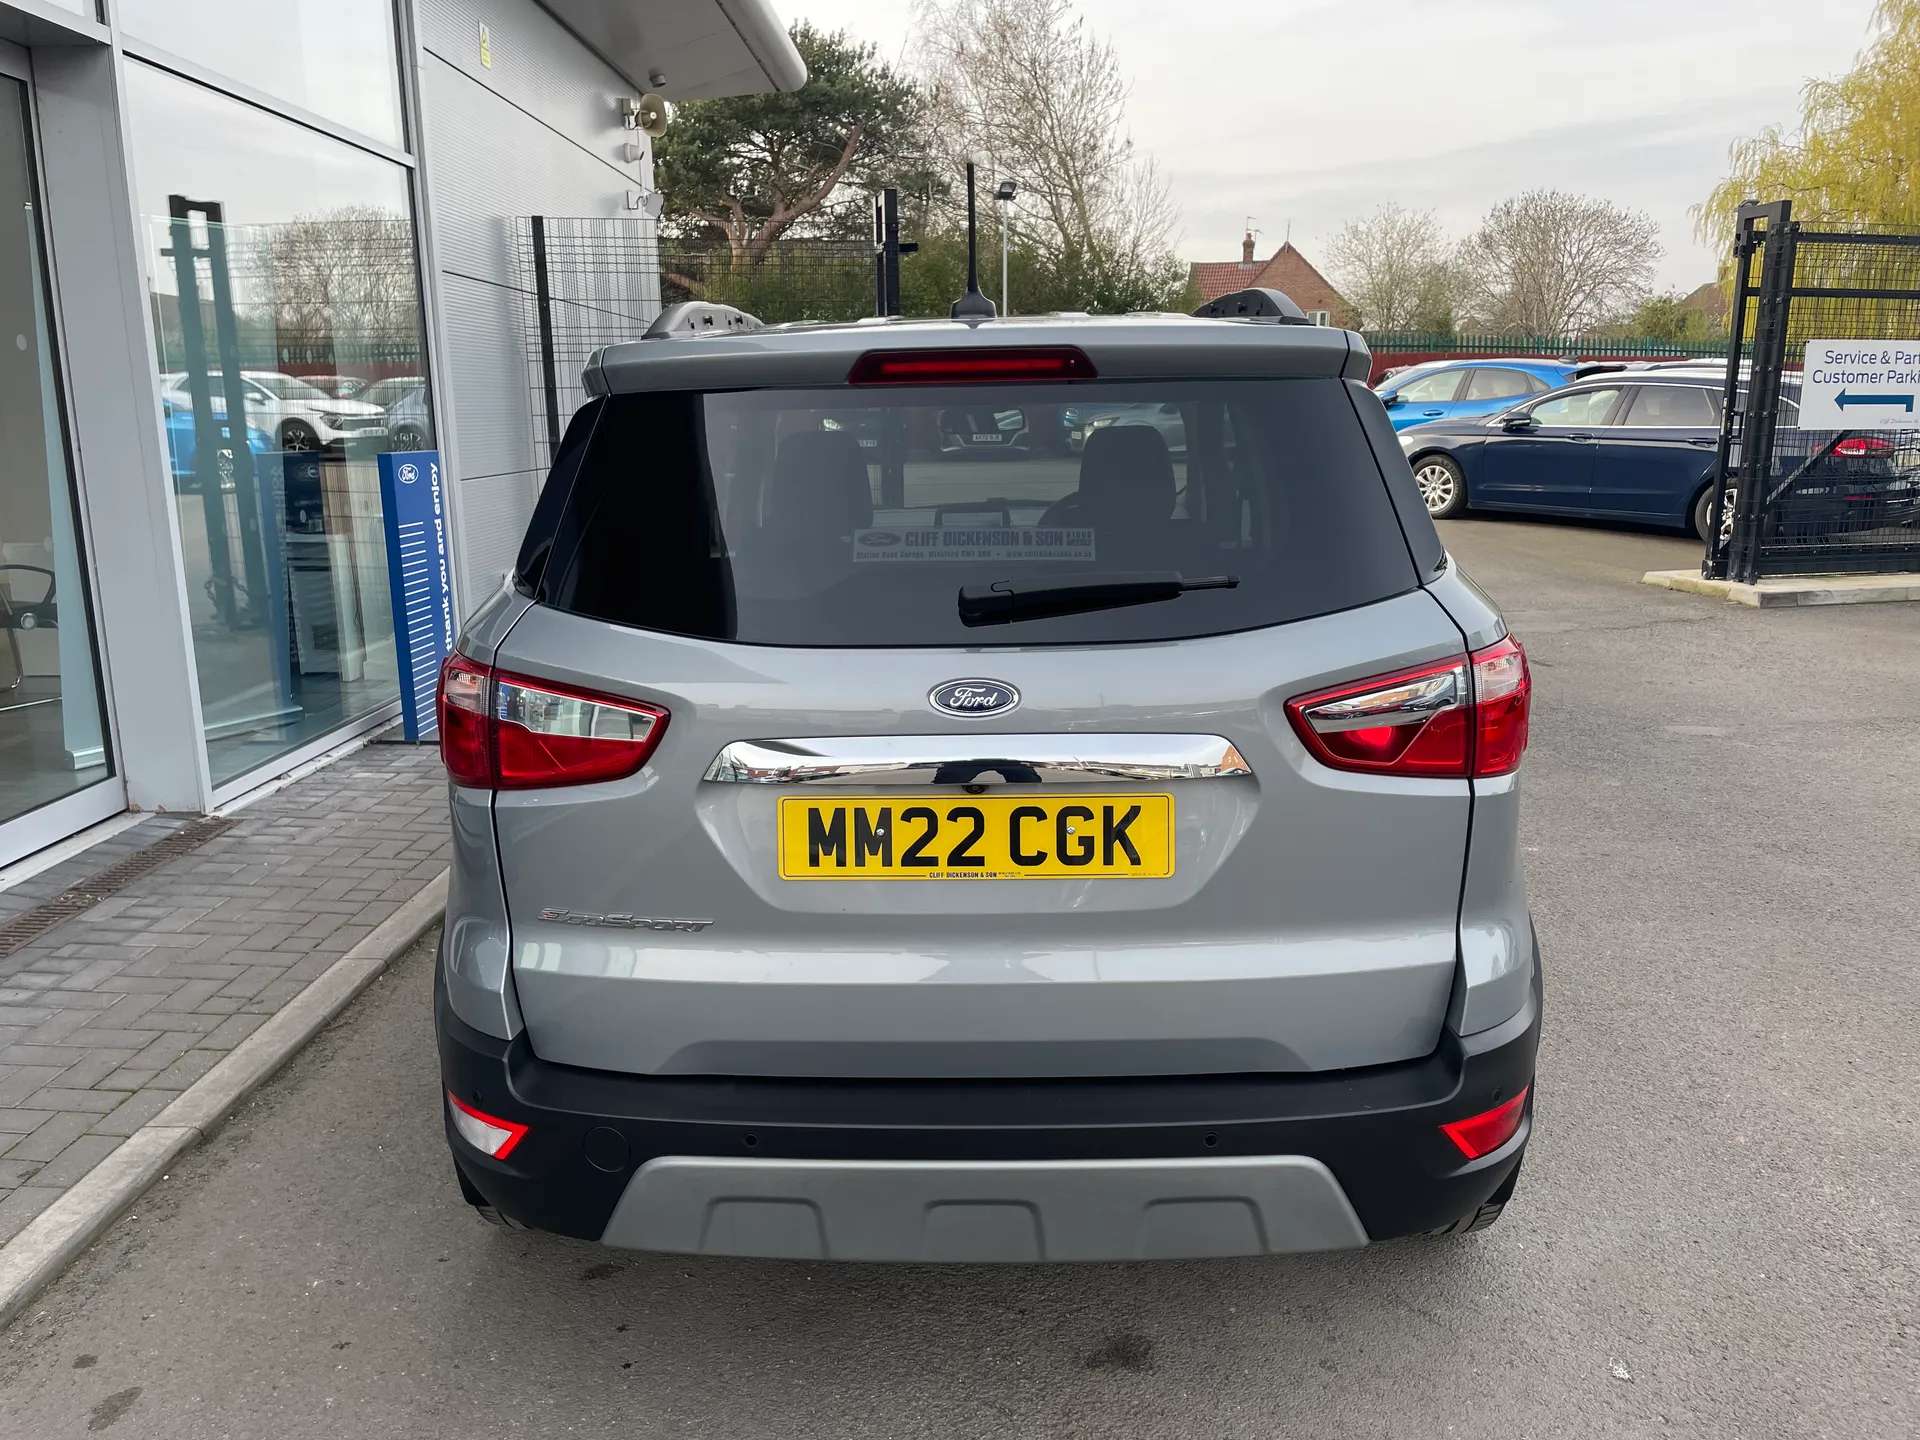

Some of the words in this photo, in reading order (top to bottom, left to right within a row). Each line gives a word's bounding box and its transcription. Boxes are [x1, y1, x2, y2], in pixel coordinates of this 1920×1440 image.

[1824, 350, 1877, 365] Service
[1880, 350, 1891, 365] &
[1813, 369, 1884, 384] Customer
[430, 461, 441, 516] enjoy
[434, 518, 445, 556] and
[905, 531, 938, 547] CLIFF
[943, 531, 1019, 546] DICKENSON
[1036, 531, 1063, 546] SON
[439, 560, 448, 594] you
[441, 596, 453, 651] thank
[950, 687, 998, 707] Ford
[808, 806, 985, 868] MM22
[1009, 805, 1142, 867] CGK
